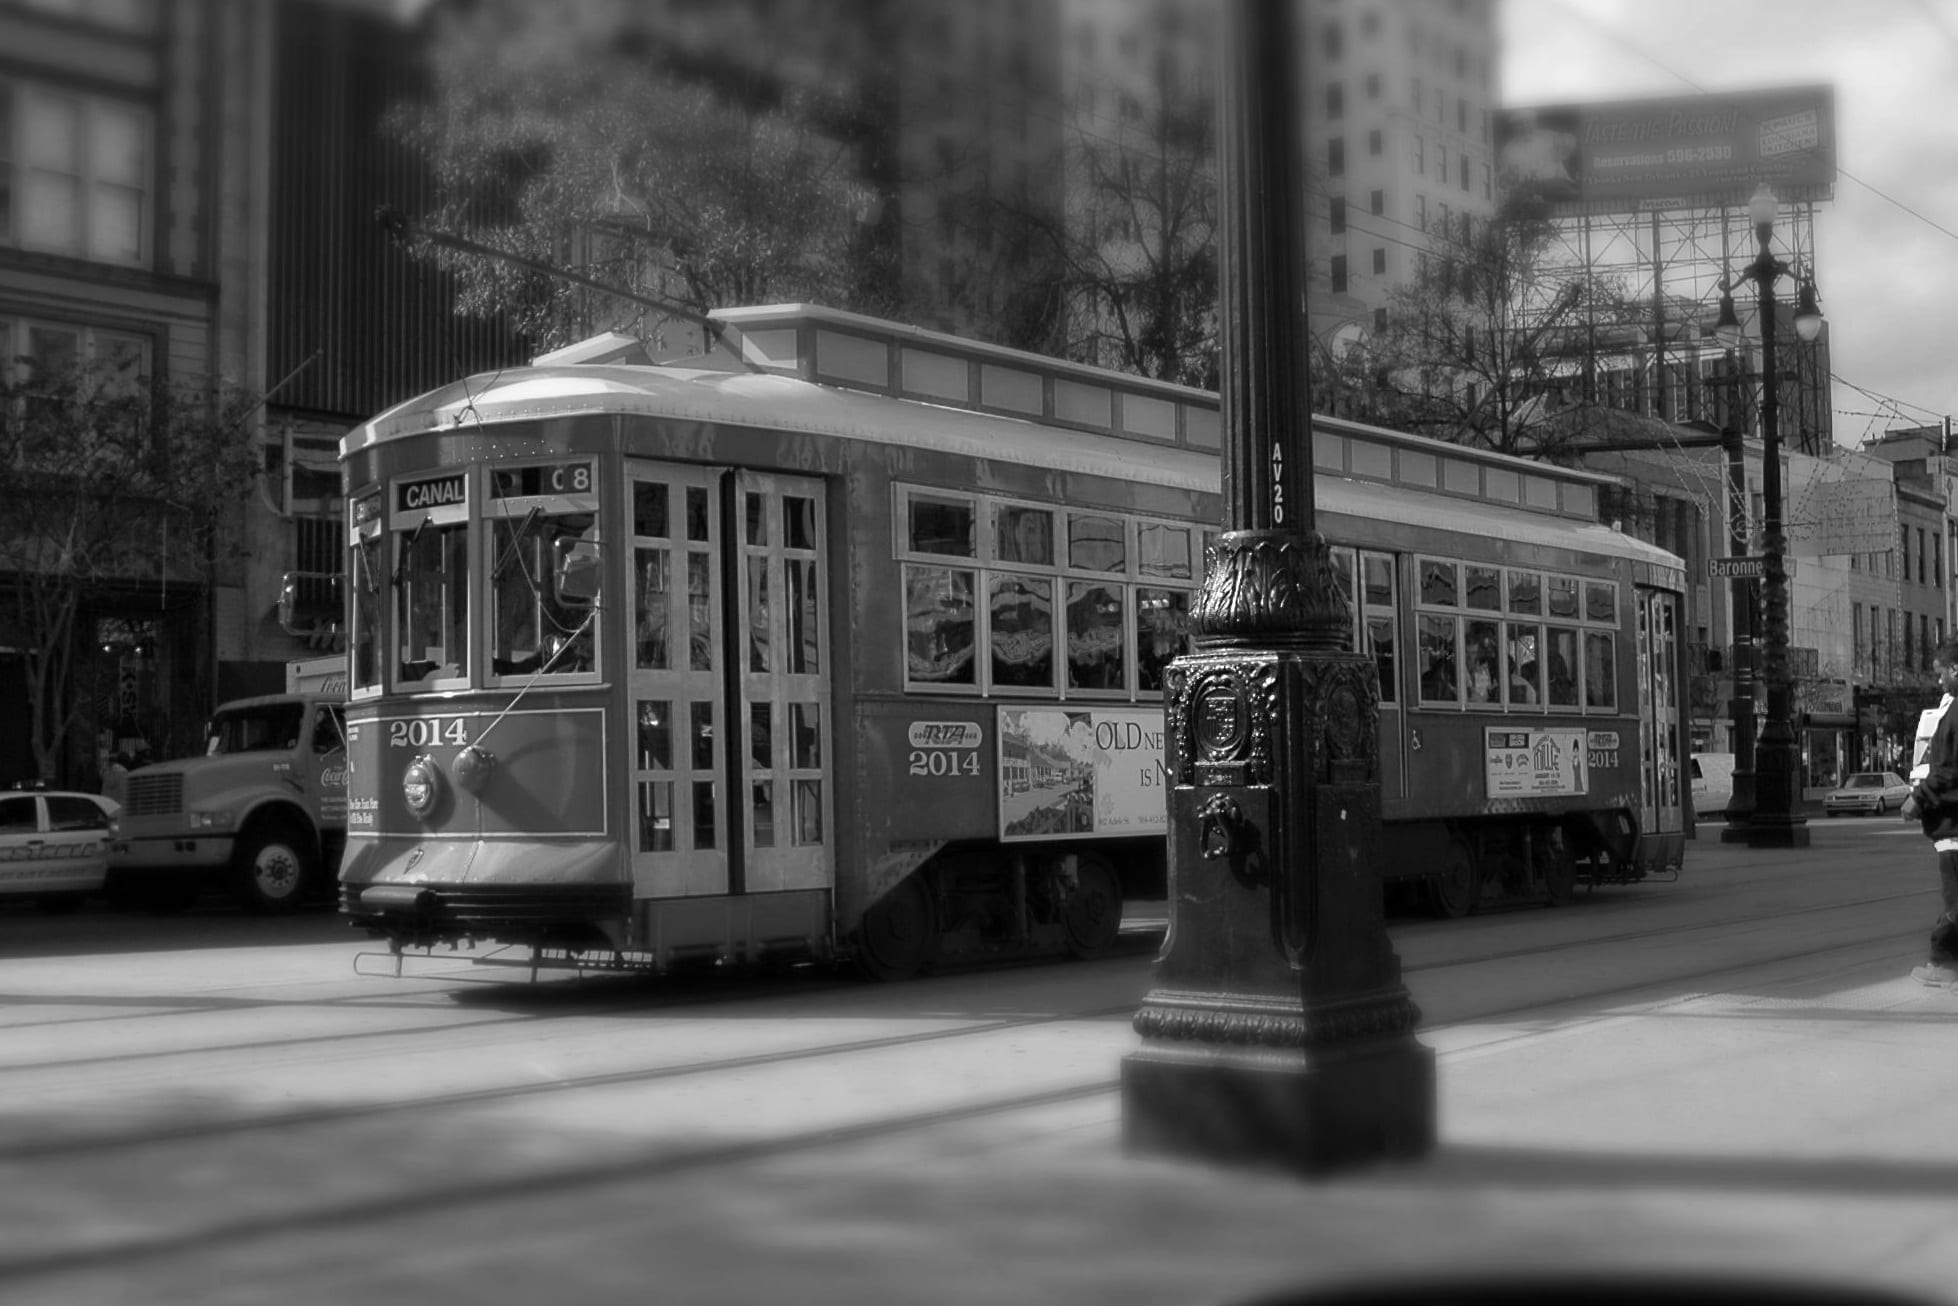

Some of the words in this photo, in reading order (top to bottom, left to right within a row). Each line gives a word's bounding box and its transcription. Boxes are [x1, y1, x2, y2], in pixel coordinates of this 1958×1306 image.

[1593, 153, 1664, 168] Reservations
[406, 480, 464, 508] CANAL
[1272, 442, 1284, 524] AV20
[1709, 559, 1763, 576] Baronne
[390, 718, 468, 747] 2014
[923, 725, 967, 744] RTA
[1095, 721, 1142, 750] OLD
[909, 751, 980, 776] 2014
[1588, 751, 1618, 768] 2014
[1140, 769, 1152, 787] IS
